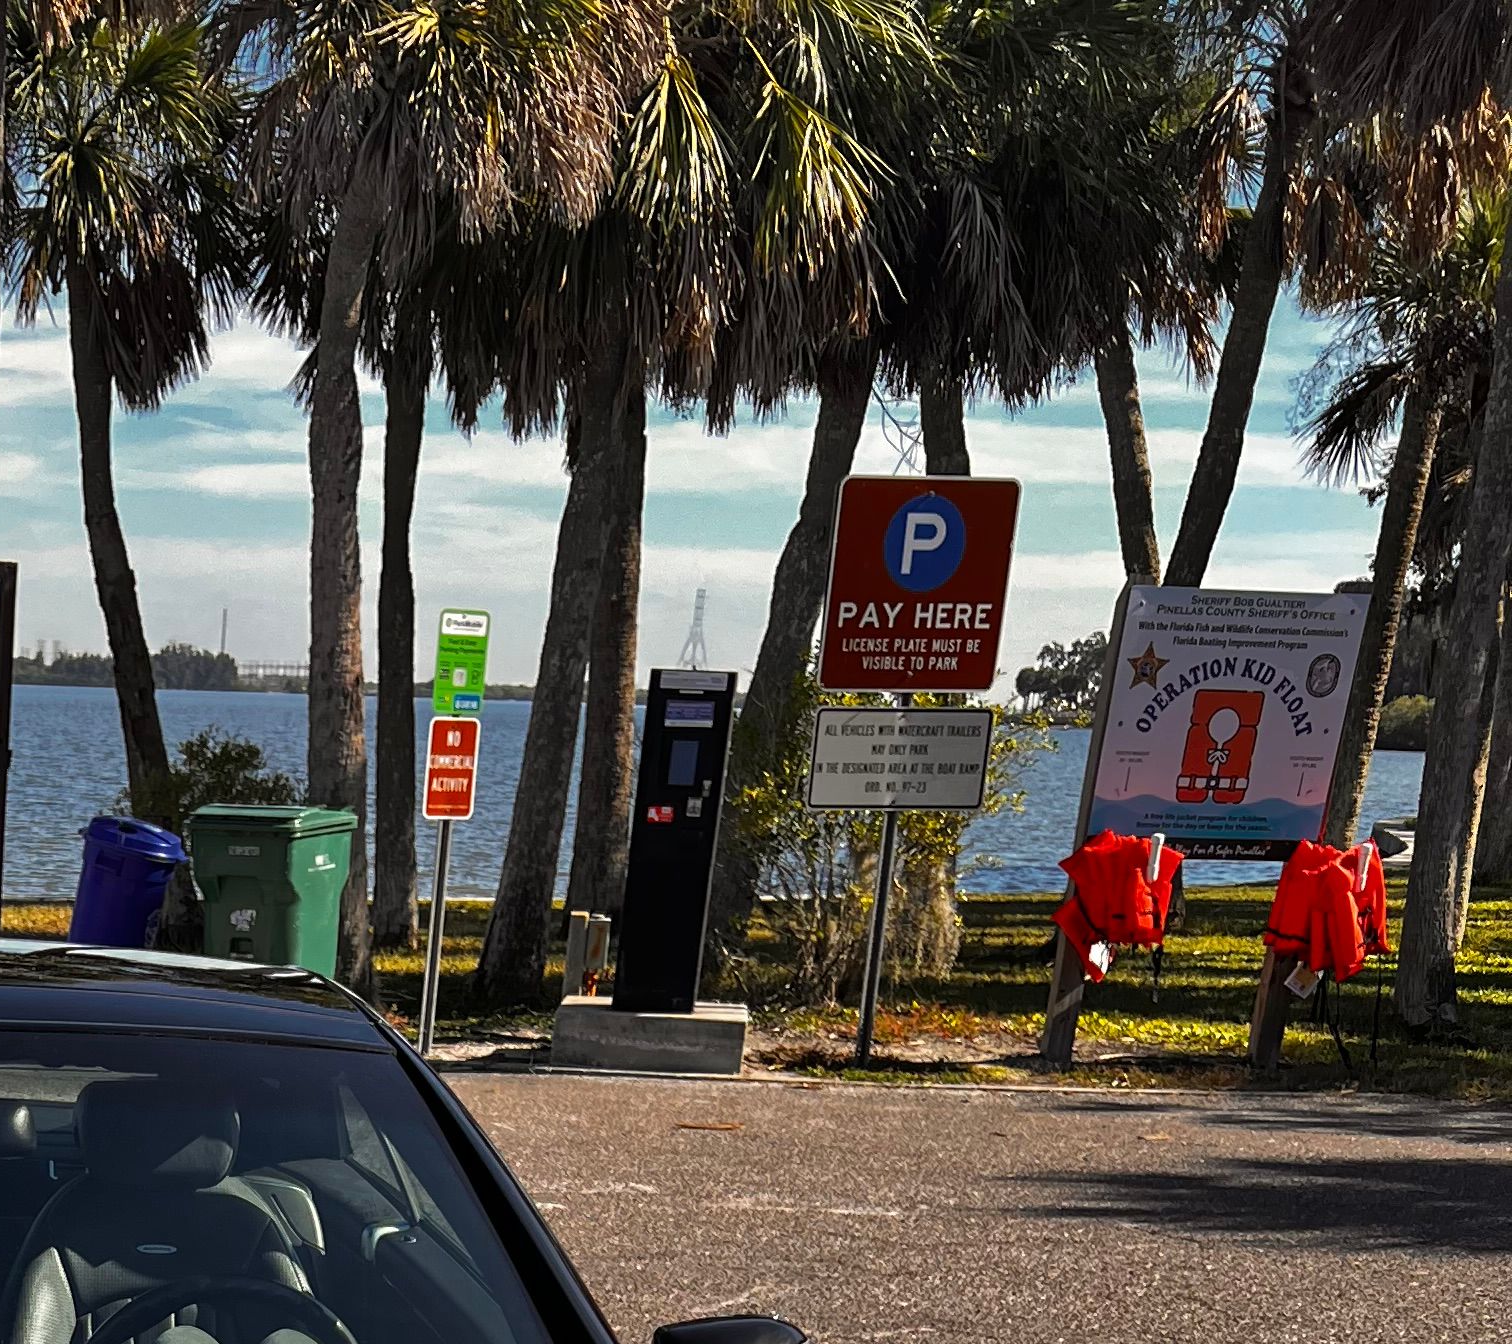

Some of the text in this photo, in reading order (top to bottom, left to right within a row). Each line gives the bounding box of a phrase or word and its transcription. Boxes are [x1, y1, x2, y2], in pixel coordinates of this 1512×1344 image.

[901, 512, 947, 575] P
[1191, 595, 1306, 609] SHERIFF BOB GUALTIERI
[838, 602, 993, 630] PAY HERE
[1156, 604, 1336, 621] PINELLAS COUNTY SHERIFF'S OFFICE
[1138, 621, 1349, 638] With the Florida Fish and Wildlife Conservation Commission's
[842, 638, 981, 653] LICENSE PLATE MUST BE
[1172, 636, 1309, 651] Florida Boating Improvement Program
[862, 656, 958, 671] VISIBLE TO PARK
[1136, 657, 1239, 733] OPERATION
[1240, 658, 1276, 686] KID
[1273, 676, 1313, 737] FLOAT
[446, 730, 461, 748] NO
[824, 725, 982, 738] ALL VEHICLES WITH WATERCRAFT TRAILERS
[871, 744, 929, 756] MAY ONLY PARK
[826, 763, 839, 774] THE
[842, 763, 886, 774] DESIGNATED
[889, 763, 907, 774] AREA
[909, 763, 918, 775] AT
[921, 763, 934, 775] THE
[937, 763, 956, 775] BOAT
[431, 777, 469, 792] ACTIVITY
